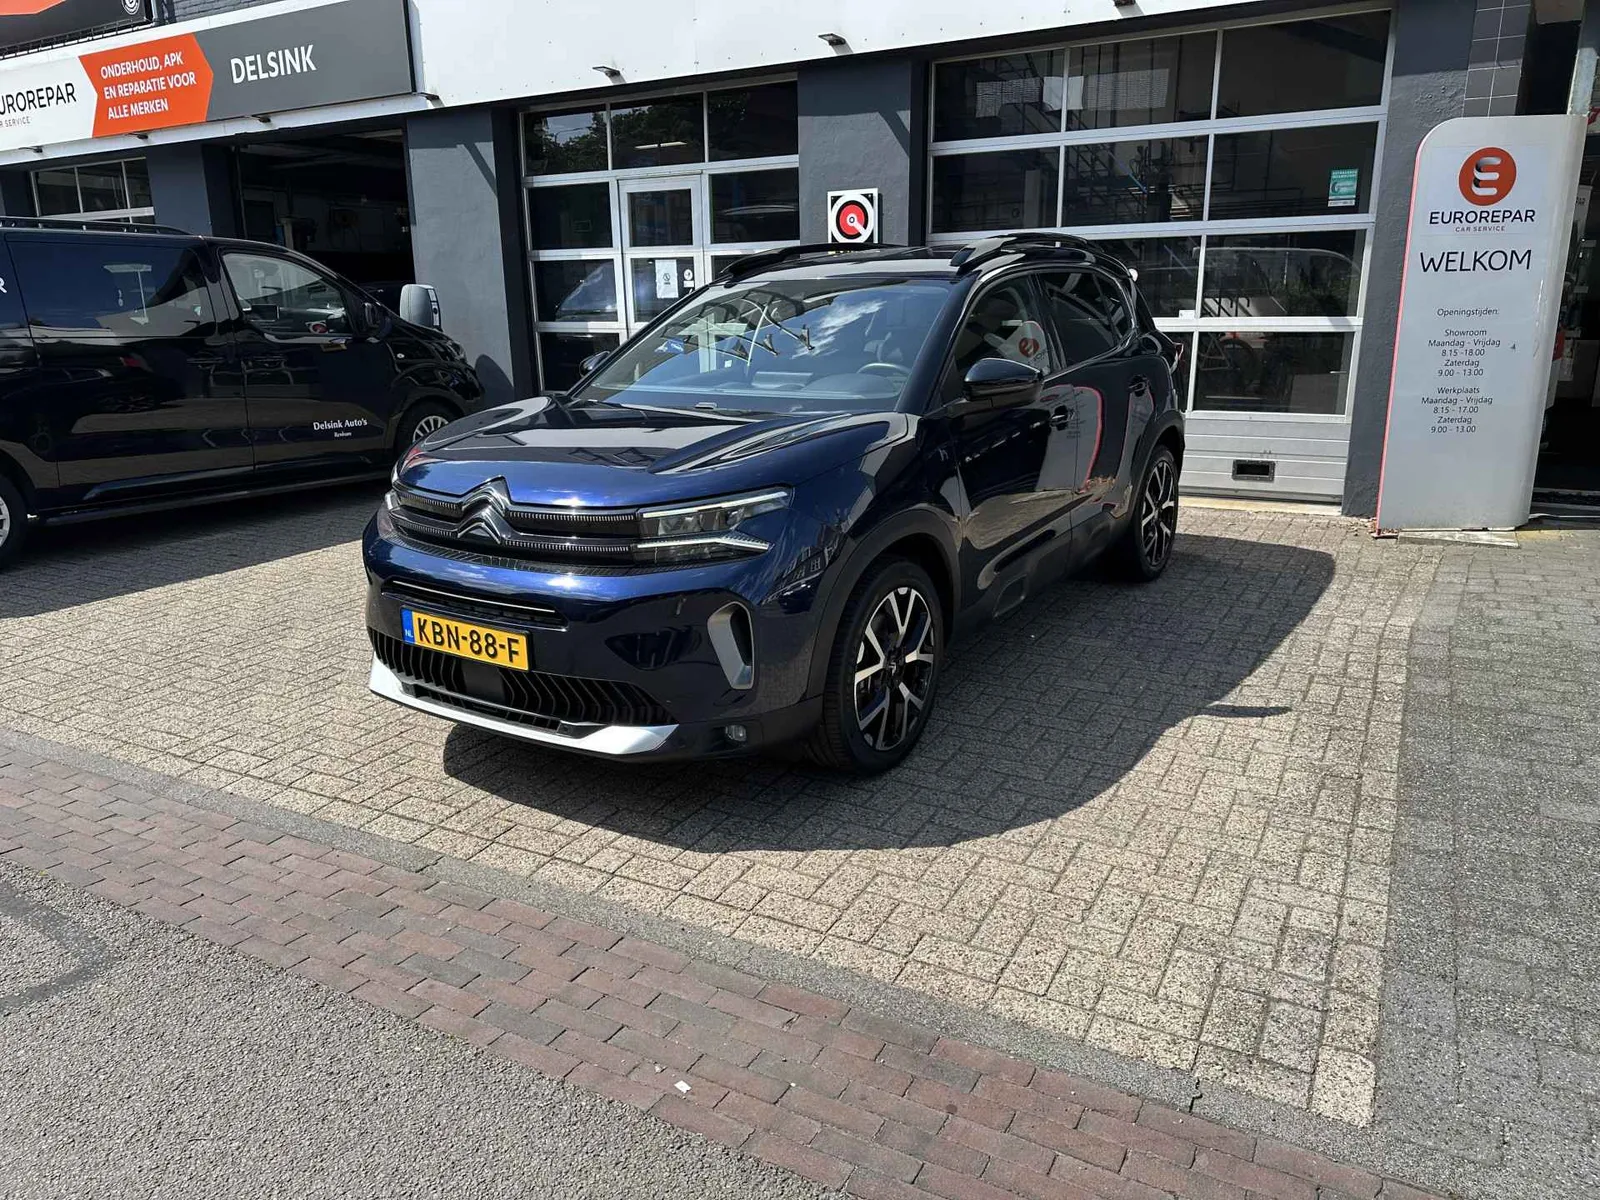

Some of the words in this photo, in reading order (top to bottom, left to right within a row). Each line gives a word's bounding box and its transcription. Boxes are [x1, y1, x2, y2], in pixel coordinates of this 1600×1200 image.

[100, 56, 162, 79] ONDERHOUD,
[164, 51, 184, 68] APK
[230, 44, 317, 84] DELSINK
[104, 85, 116, 100] EN
[117, 77, 166, 97] REPARATIE
[167, 72, 197, 89] VOOR
[108, 104, 130, 120] ALLE
[130, 98, 169, 116] MERKEN
[5, 116, 30, 127] SERVICE
[1429, 209, 1536, 225] EUROREPAR
[1420, 249, 1532, 273] WELKOM
[1428, 340, 1465, 348] Maandag
[1473, 339, 1501, 347] Vrijdag
[1442, 349, 1458, 357] 8.15
[1444, 359, 1480, 368] Zaterdag
[1438, 369, 1454, 377] 9.00
[1463, 368, 1484, 376] 13.00
[1437, 387, 1480, 395] Werkplaats
[1421, 397, 1458, 405] Maandag
[1466, 396, 1493, 405] Vrijdag
[1433, 406, 1450, 414] 8.15
[313, 419, 343, 430] Delsink
[344, 418, 368, 427] Auto's
[1437, 416, 1472, 425] Zaterdag
[1431, 426, 1448, 434] 9.00
[404, 629, 413, 638] NL
[417, 617, 520, 663] KBN-88-F
